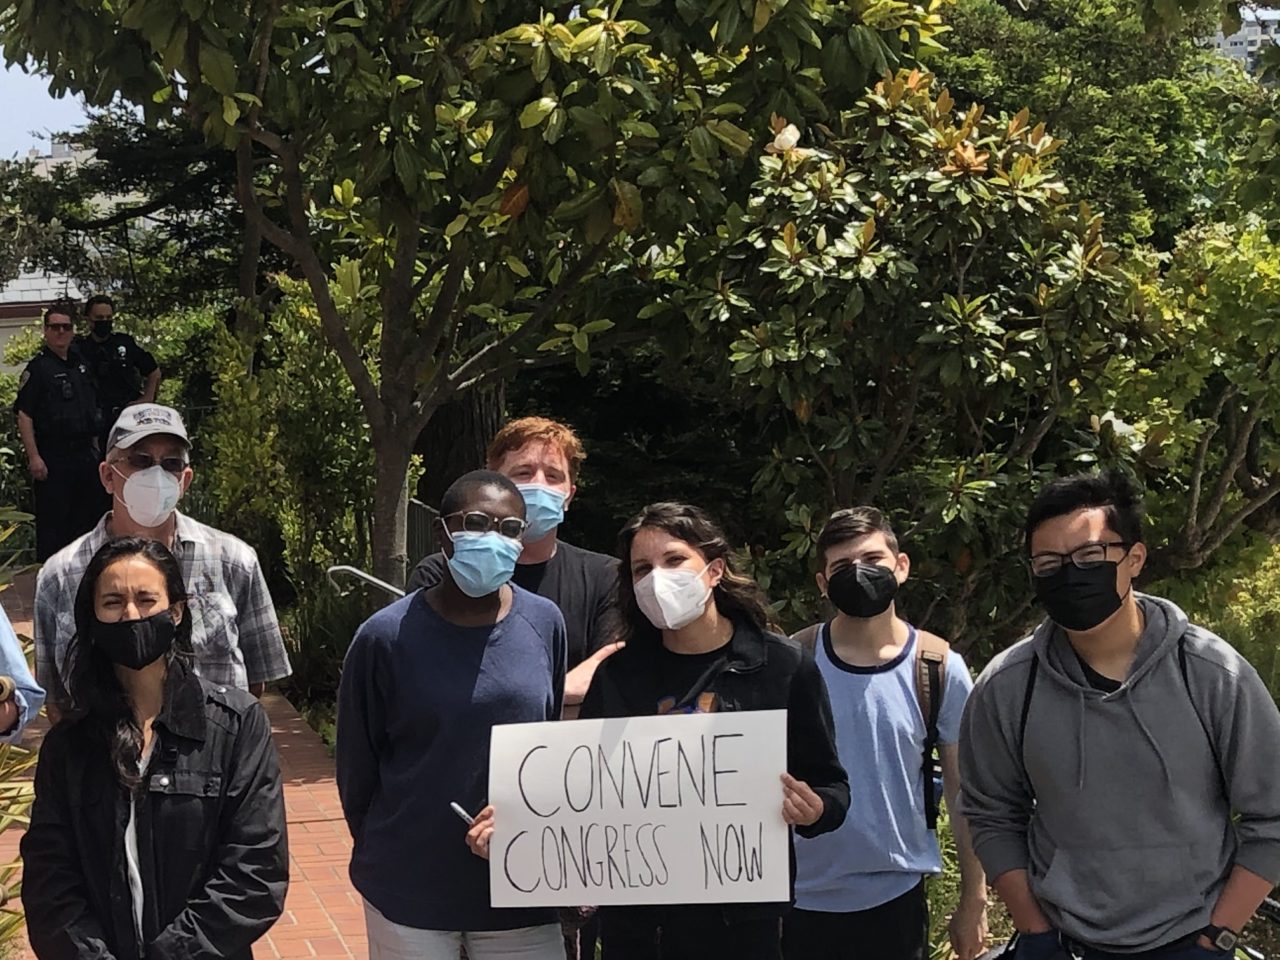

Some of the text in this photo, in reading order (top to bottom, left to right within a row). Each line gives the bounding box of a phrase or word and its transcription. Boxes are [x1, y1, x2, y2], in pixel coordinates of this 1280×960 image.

[518, 733, 748, 818] CONVENE
[504, 821, 764, 893] CONGRESS NOW
